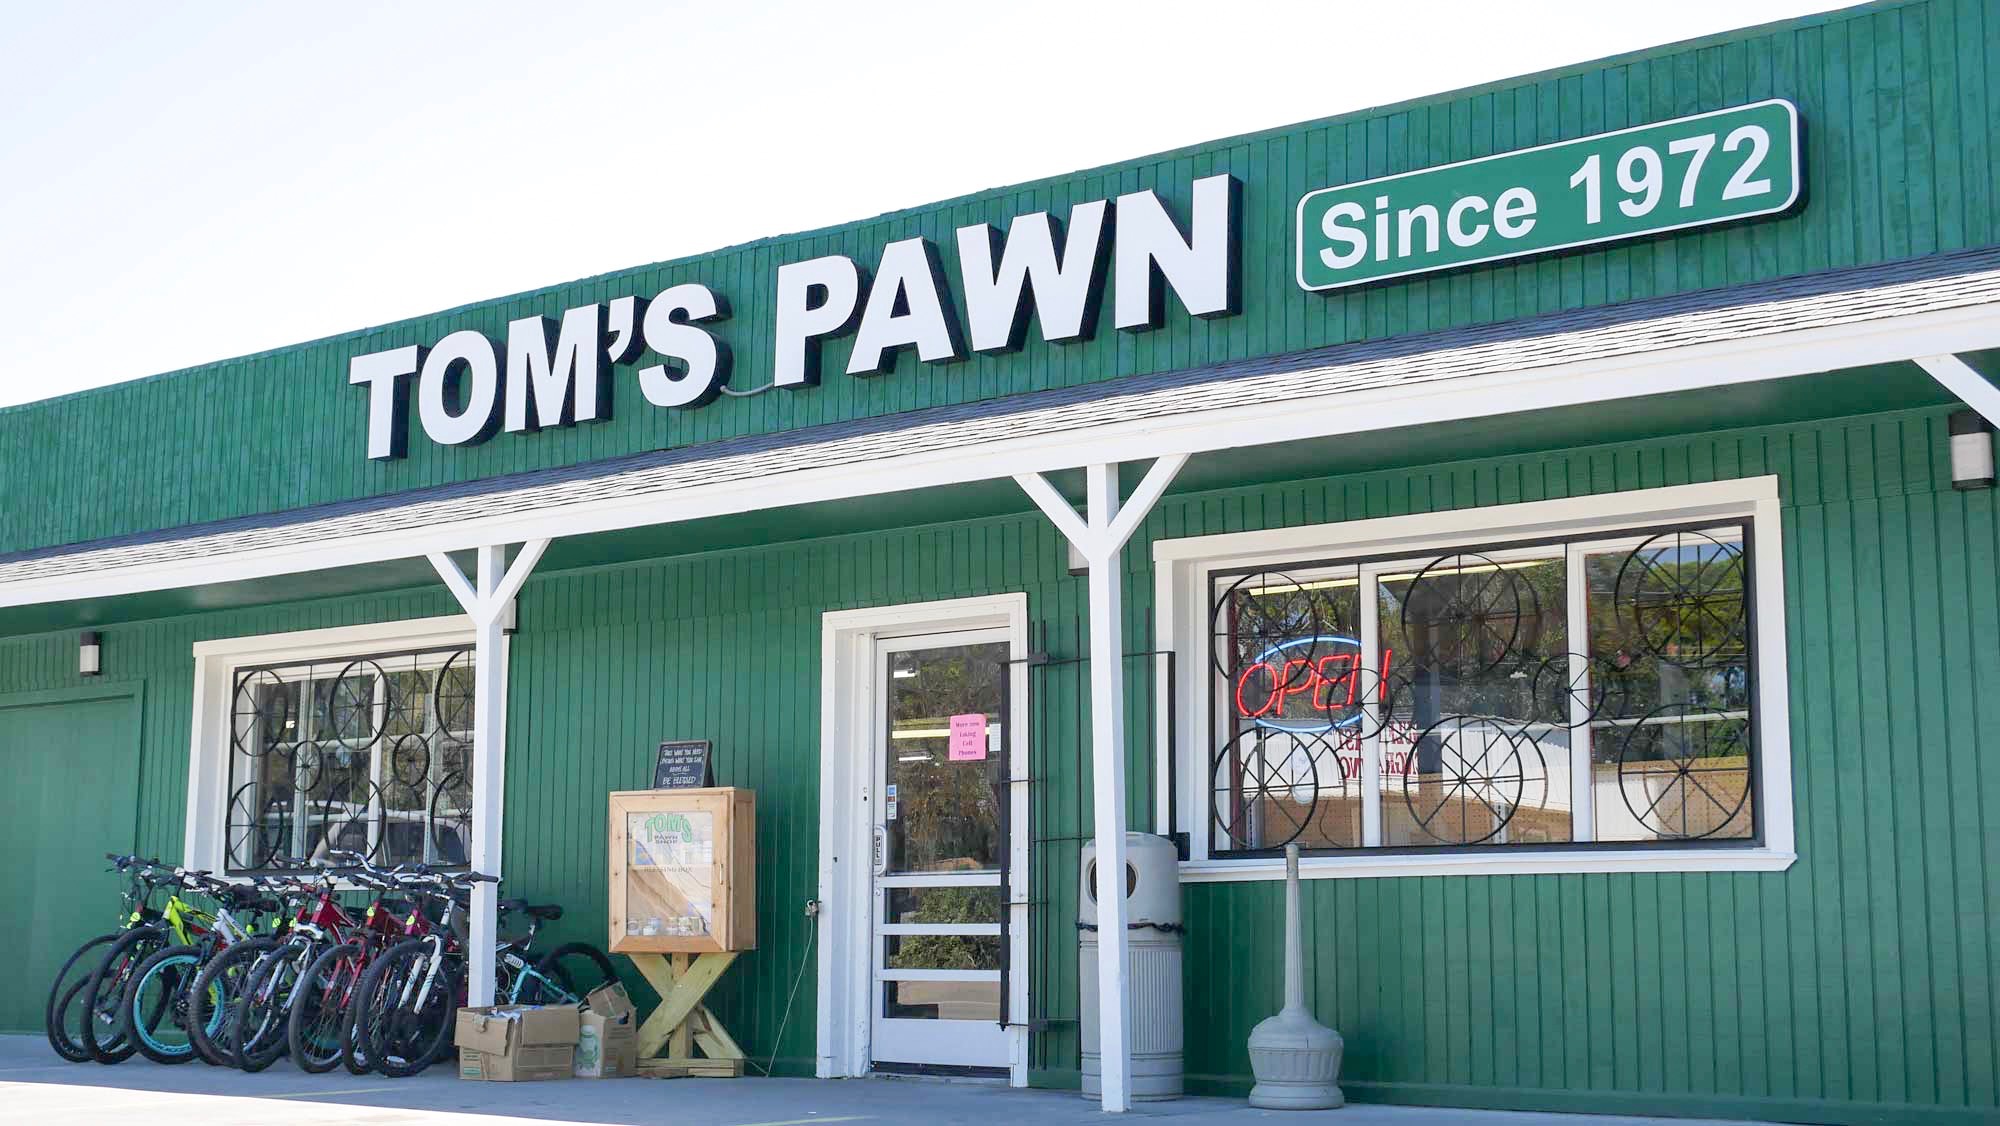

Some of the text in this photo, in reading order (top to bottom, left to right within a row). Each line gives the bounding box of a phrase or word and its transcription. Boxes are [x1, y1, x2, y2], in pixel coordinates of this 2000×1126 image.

[1319, 124, 1772, 270] Since 1972
[349, 173, 1235, 460] TOM'S PAWN
[644, 813, 692, 843] TOM'S
